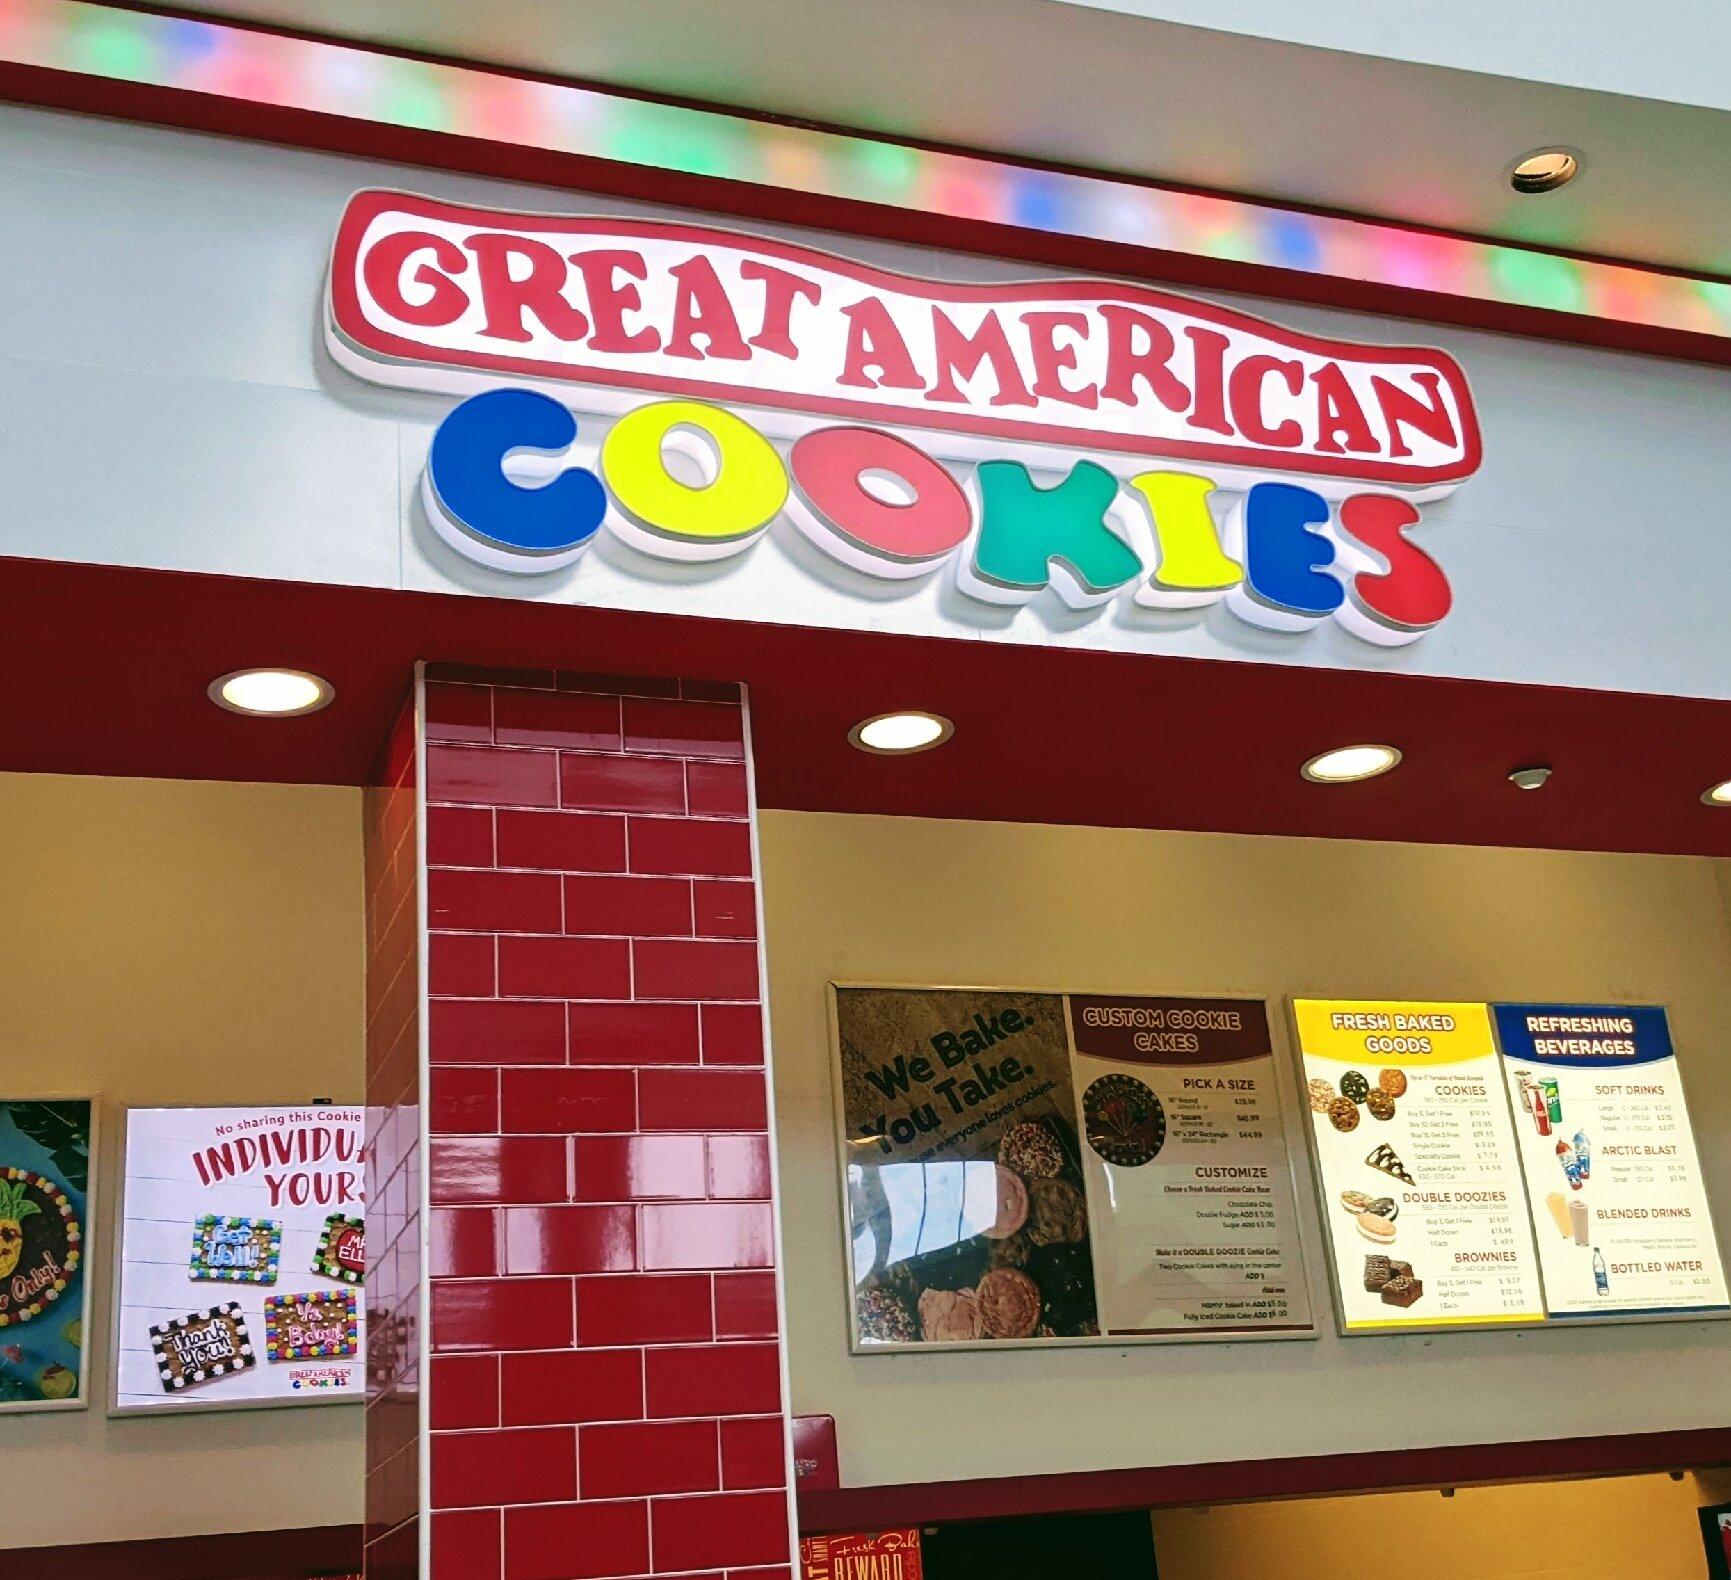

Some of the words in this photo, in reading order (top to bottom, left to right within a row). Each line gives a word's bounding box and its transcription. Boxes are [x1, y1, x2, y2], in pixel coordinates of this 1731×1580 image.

[363, 230, 823, 362] GREAT
[838, 297, 1461, 458] AMERICAN
[427, 387, 1452, 634] COOKIES
[1083, 1007, 1164, 1028] CUSTOM
[1167, 1010, 1242, 1031] COOKIE
[1332, 1014, 1391, 1031] FRESH
[1393, 1014, 1456, 1031] BAKED
[1526, 1016, 1633, 1034] REFRESHING
[1134, 1032, 1199, 1053] CAKES
[1365, 1036, 1432, 1053] GOODS
[1535, 1039, 1635, 1055] BEVERAGES
[864, 1055, 936, 1100] We
[931, 1009, 1034, 1070] Bake.
[1183, 1079, 1213, 1089] PICK
[1216, 1079, 1226, 1090] A
[1228, 1080, 1256, 1091] SIZE
[1434, 1085, 1487, 1096] COOKIES
[1595, 1085, 1623, 1095] SOFT
[1625, 1085, 1665, 1095] DRINKS
[859, 1102, 942, 1155] You
[933, 1057, 1034, 1115] Take.
[215, 1125, 233, 1136] No
[237, 1115, 285, 1131] sharing
[289, 1112, 313, 1123] this
[317, 1111, 362, 1122] Cookie
[1199, 1131, 1229, 1139] Rectangle
[1432, 1141, 1451, 1149] Cookie
[1602, 1145, 1641, 1155] ARCTIC
[1644, 1145, 1677, 1155] BLAST
[1195, 1167, 1268, 1178] CUSTOMIZE
[1402, 1192, 1452, 1203] DOUBLE
[1454, 1191, 1507, 1203] DOOZIES
[1258, 1201, 1273, 1209] Chip
[1219, 1211, 1239, 1219] Fudge
[1596, 1208, 1649, 1219] BLENDED
[1651, 1207, 1692, 1218] DRINKS
[212, 1225, 252, 1245] Get
[1183, 1248, 1214, 1256] DOUBLE
[1216, 1248, 1246, 1256] DOOZIE
[1454, 1251, 1517, 1263] BROWNIES
[1610, 1262, 1661, 1274] BOTTLED
[1664, 1260, 1703, 1272] WATER
[11, 1250, 61, 1303] Only!
[1245, 1272, 1260, 1280] ADD
[1252, 1300, 1267, 1308] ADD
[1183, 1312, 1199, 1321] Fully
[1215, 1312, 1236, 1320] Cookie
[1253, 1311, 1268, 1319] ADD
[163, 1319, 231, 1352] Thank
